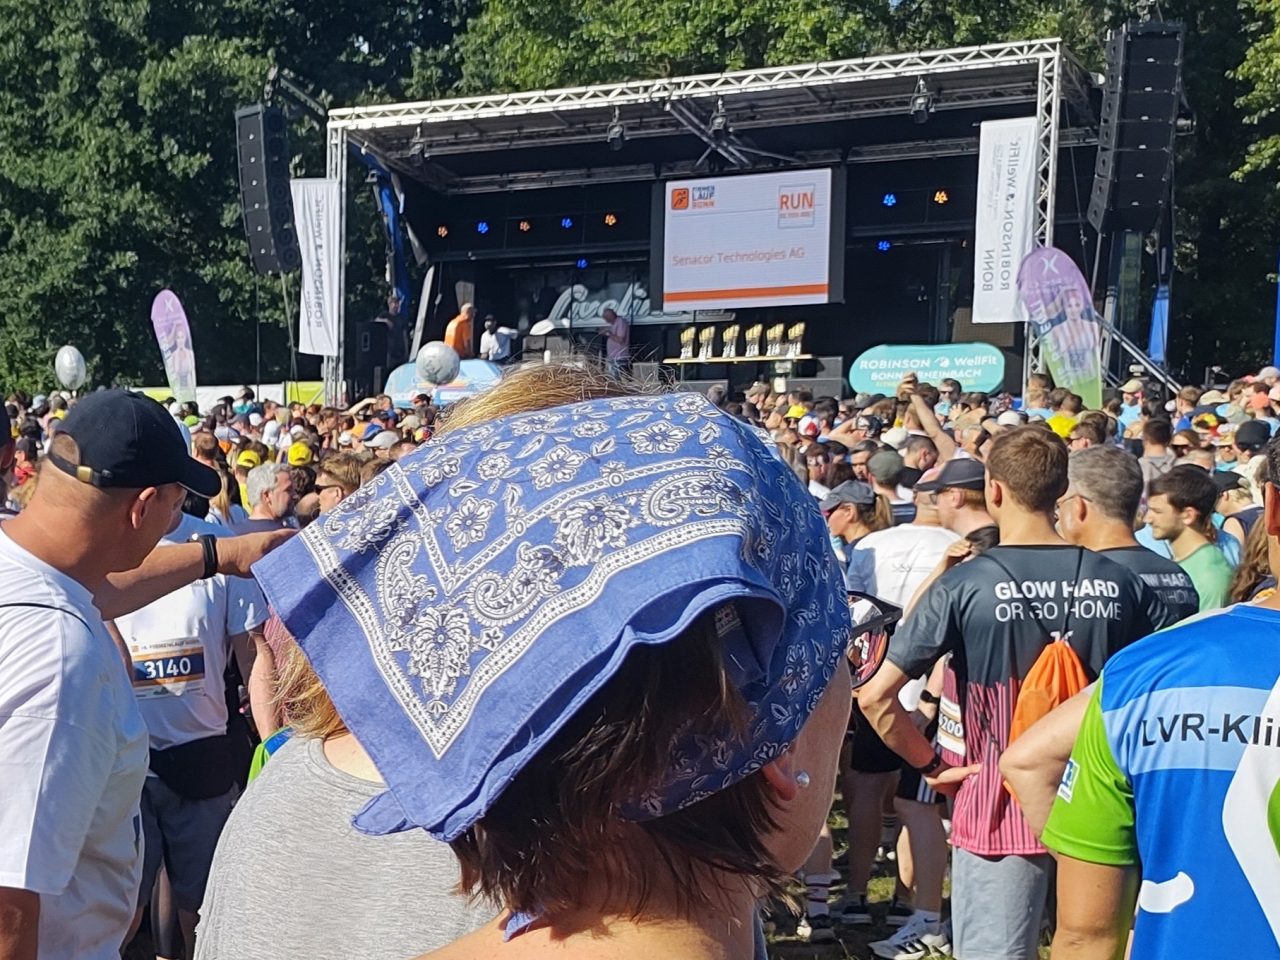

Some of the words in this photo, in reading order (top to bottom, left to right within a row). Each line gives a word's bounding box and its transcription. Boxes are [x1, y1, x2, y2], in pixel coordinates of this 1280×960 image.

[780, 192, 813, 210] RUN
[672, 254, 714, 267] Senacor
[717, 250, 785, 264] Technologies
[789, 247, 805, 259] AG
[859, 358, 931, 370] ROBINSON
[954, 355, 998, 366] WellFit
[871, 371, 903, 381] BONN
[995, 581, 1057, 600] GLOW
[1062, 578, 1119, 598] HARD
[995, 603, 1024, 622] OR
[1029, 602, 1058, 620] GO
[1064, 601, 1121, 621] HOME
[144, 657, 191, 679] 3140
[1142, 713, 1280, 748] LVR-Kli
